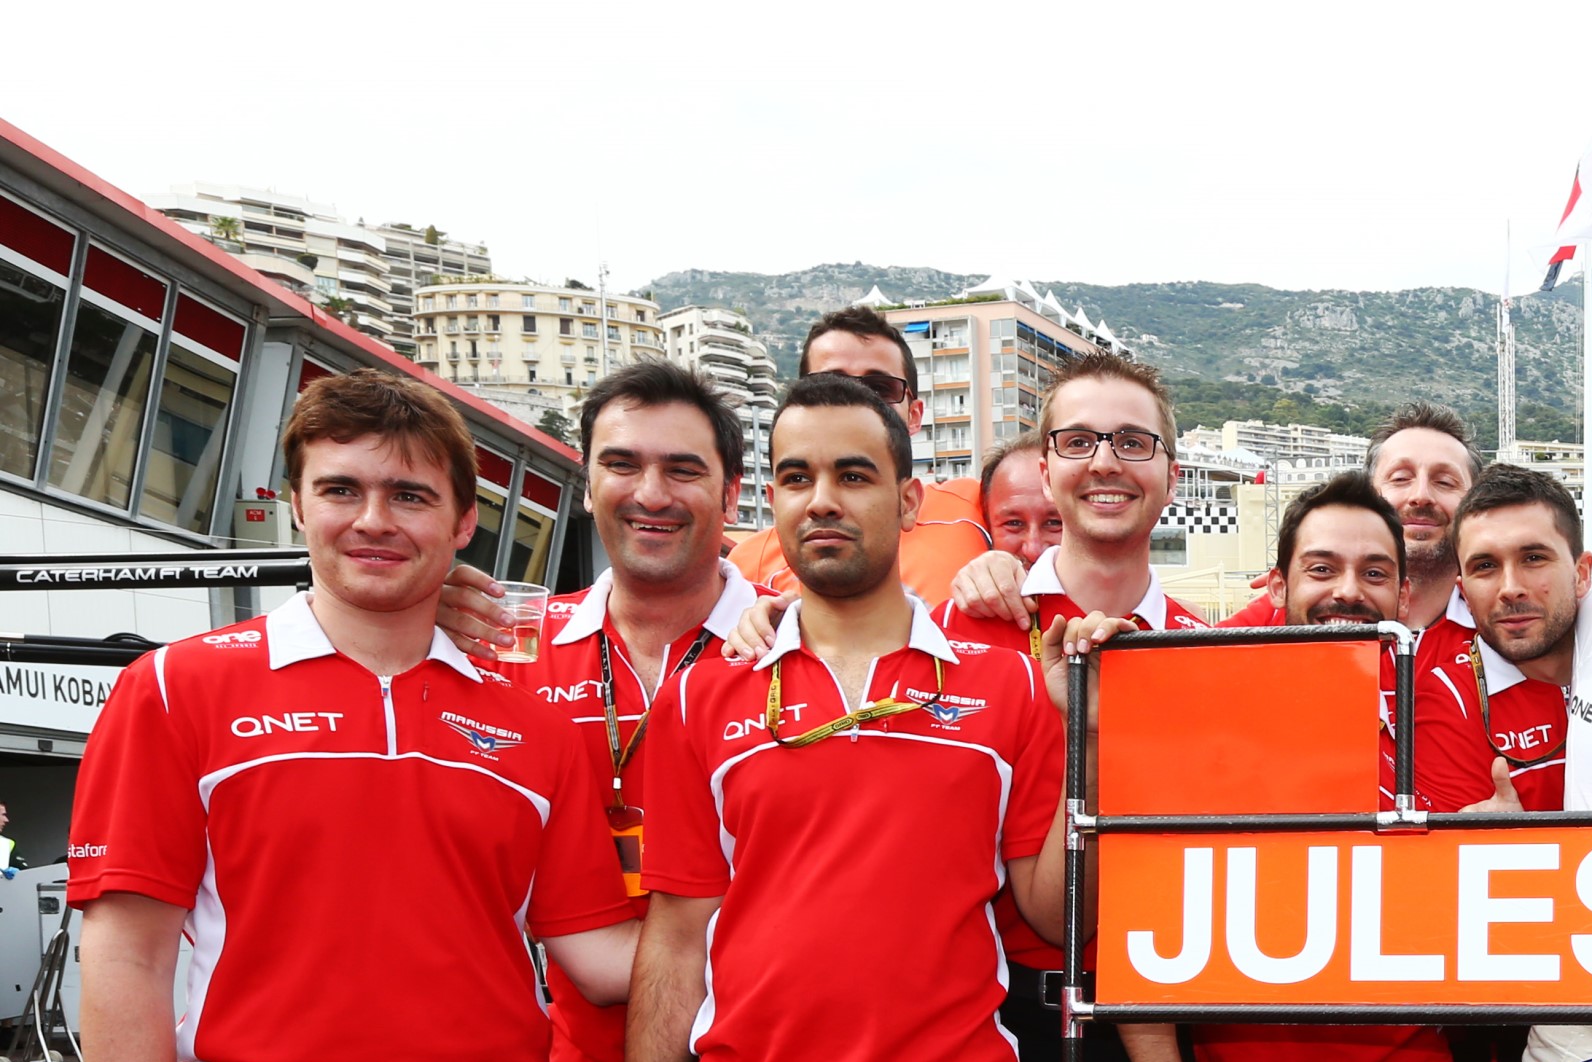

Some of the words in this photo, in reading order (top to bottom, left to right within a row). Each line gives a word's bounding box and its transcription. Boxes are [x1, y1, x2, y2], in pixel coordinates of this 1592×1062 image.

[16, 567, 156, 583] CATERHAM
[189, 566, 259, 579] TEAM
[202, 630, 262, 644] one
[231, 711, 344, 738] QNET
[441, 711, 522, 742] MARUSSIA
